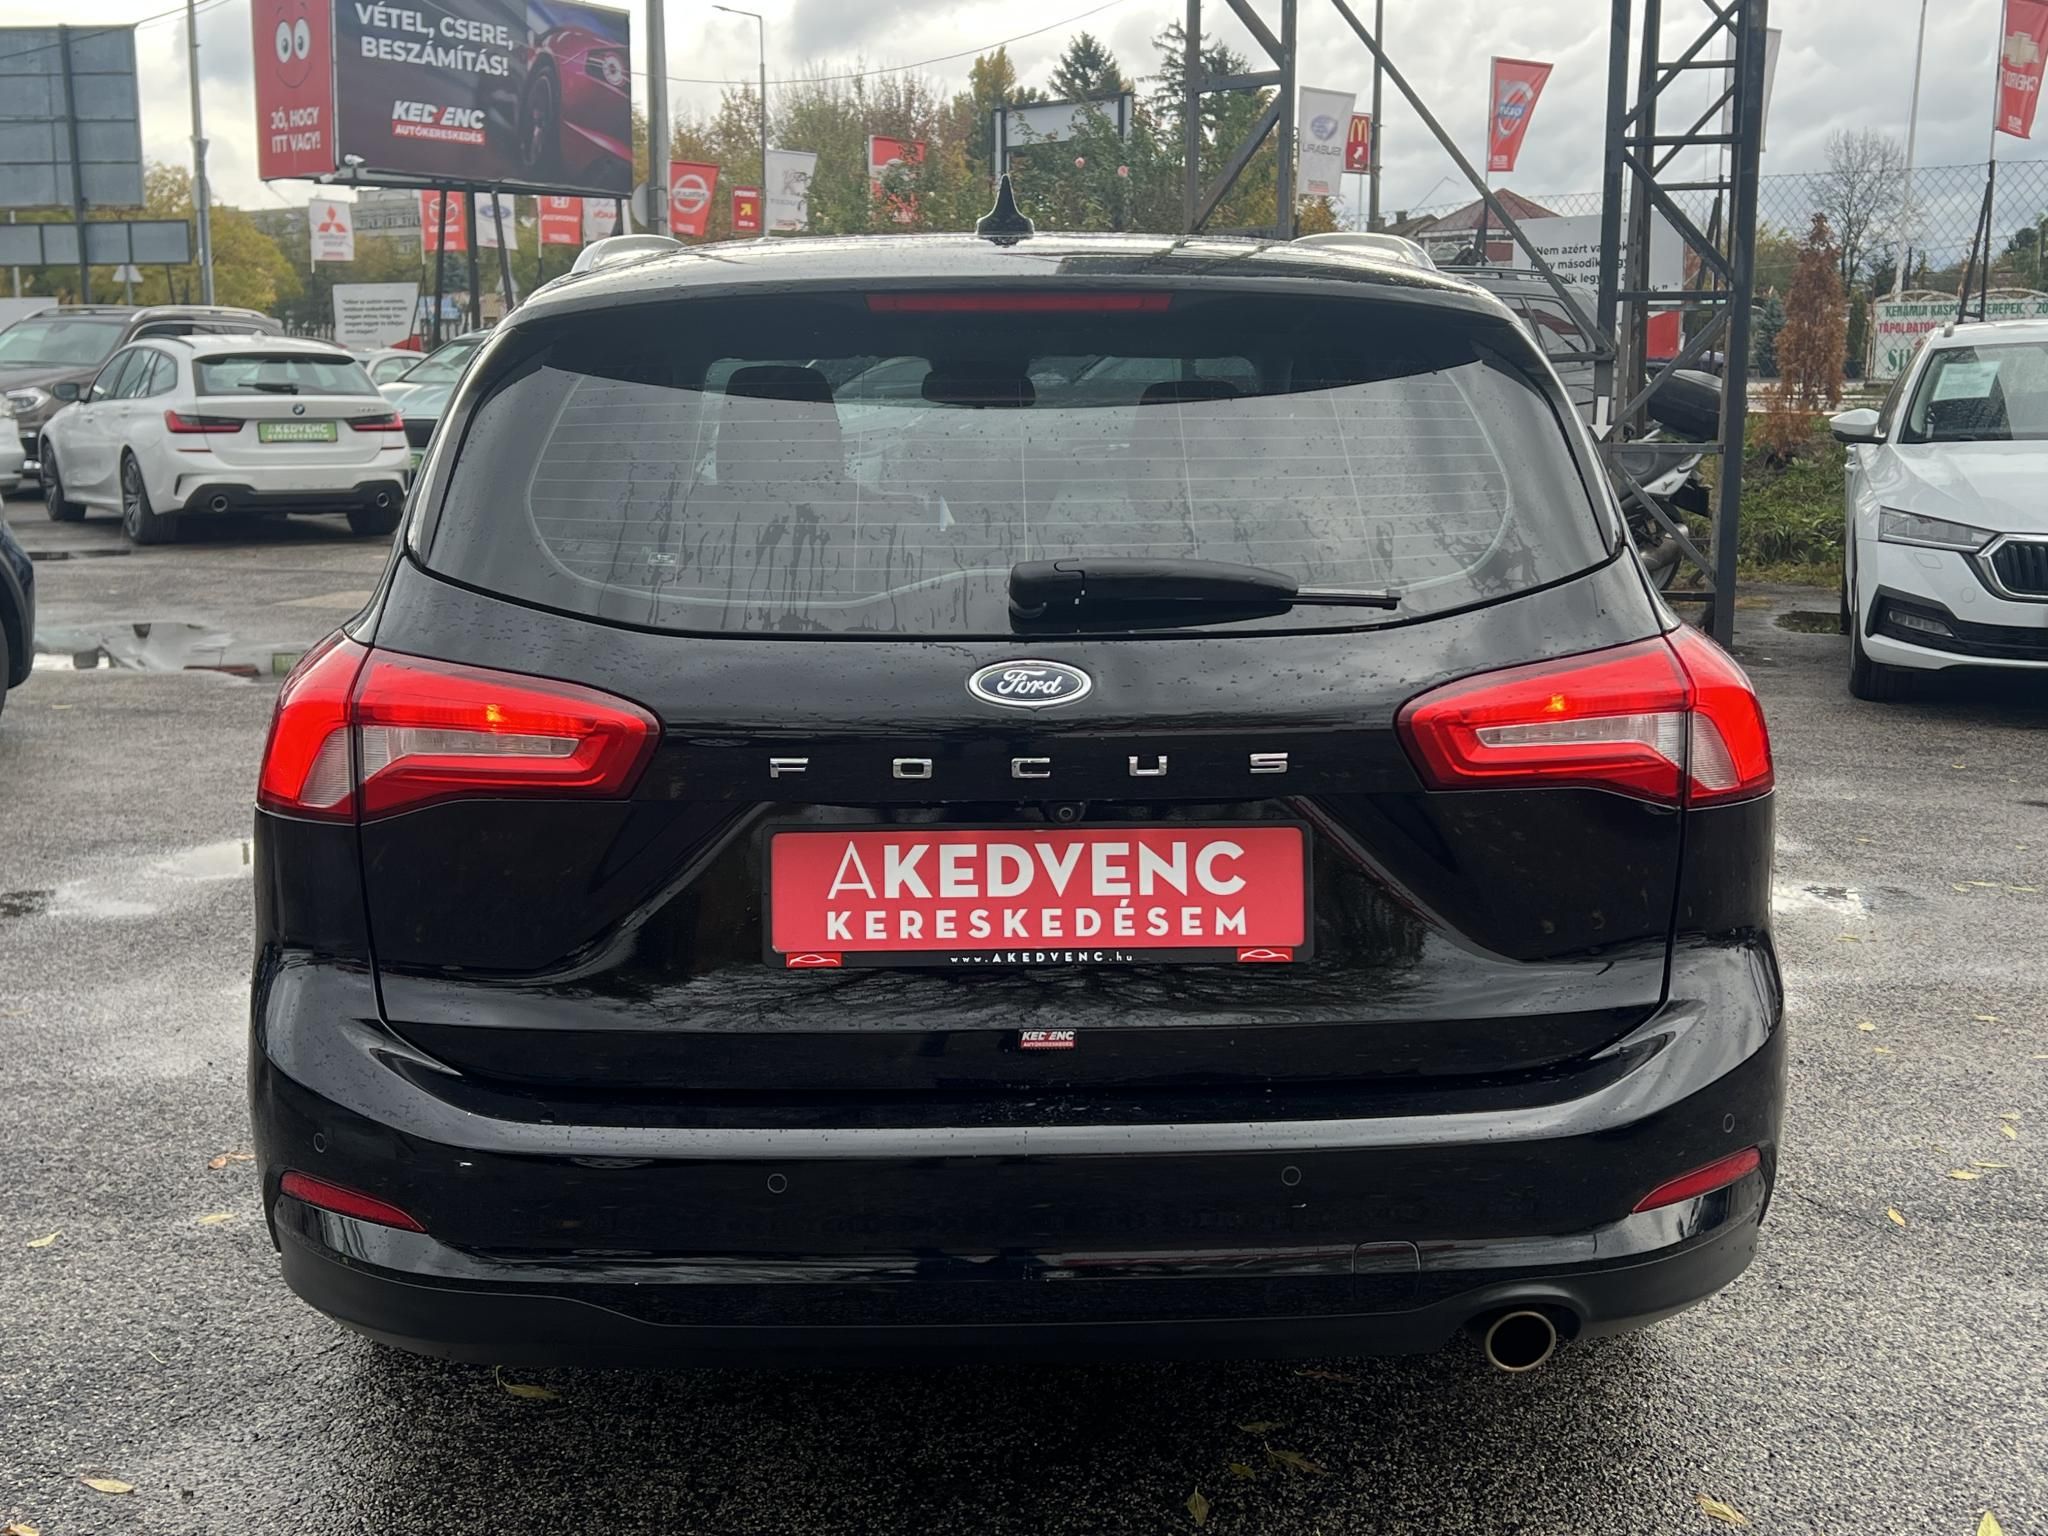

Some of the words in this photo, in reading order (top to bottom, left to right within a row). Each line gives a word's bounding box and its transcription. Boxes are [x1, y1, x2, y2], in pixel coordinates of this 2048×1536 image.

[355, 1, 435, 39] VÉTEL,
[440, 16, 514, 51] CSERE,
[361, 36, 510, 77] BESZÁMÍTÁS!
[271, 106, 288, 132] JÓ,
[290, 106, 320, 128] HOGY
[271, 134, 287, 153] ITT
[288, 131, 321, 152] VAGY!
[395, 124, 484, 143] AUTÓKERESKEDÉS
[1561, 244, 1588, 254] azért
[996, 669, 1063, 694] Ford
[769, 752, 1289, 779] FOCUS
[827, 840, 1247, 900] AKEDVENC
[827, 899, 1247, 941] KERESKEDÉSEM
[950, 951, 1133, 964] www.AKEDVENC.hu
